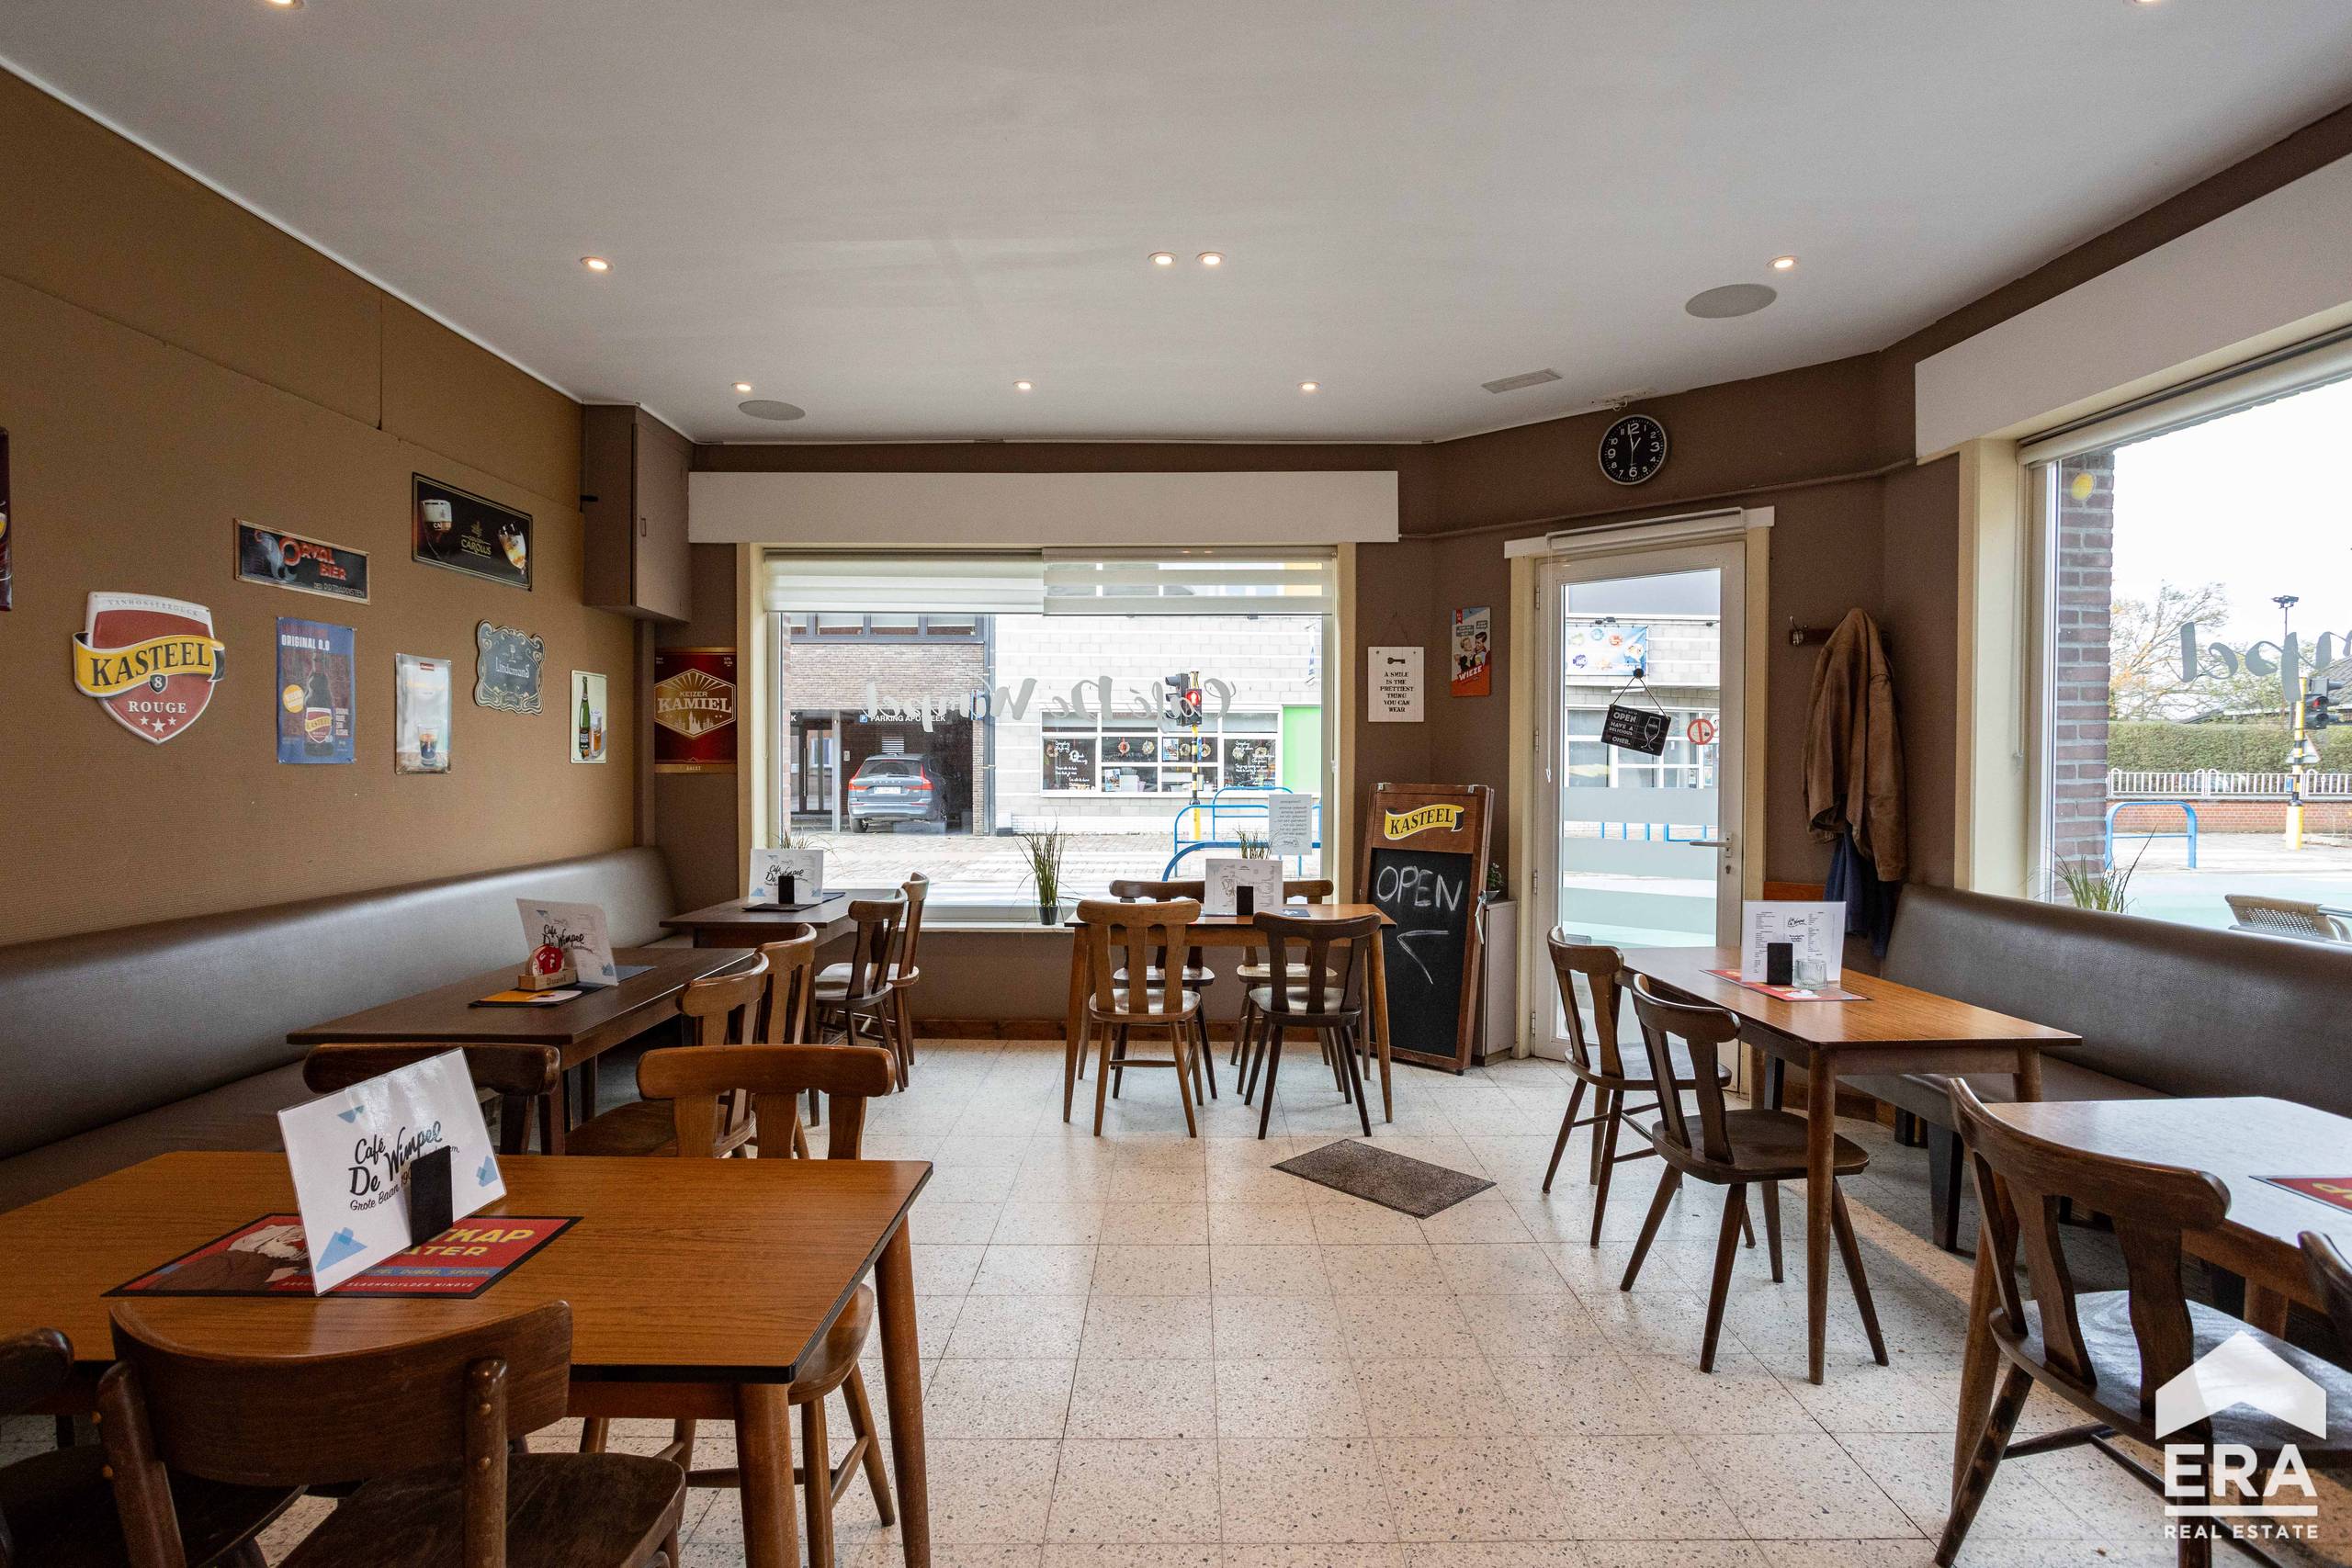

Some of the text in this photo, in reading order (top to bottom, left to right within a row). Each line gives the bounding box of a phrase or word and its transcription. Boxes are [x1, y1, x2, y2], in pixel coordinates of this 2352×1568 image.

[1607, 448, 1616, 459] 9
[1649, 441, 1660, 453] 3
[1629, 467, 1638, 478] 6
[278, 536, 336, 566] ORVAL
[319, 562, 347, 581] BIER
[281, 634, 316, 649] ORIGINAL
[90, 642, 210, 687] KASTEEL
[1458, 665, 1483, 682] WIEZE
[154, 676, 163, 688] 8
[128, 701, 187, 714] ROUGE
[657, 697, 732, 714] KAMIEL
[1613, 711, 1636, 722] OPEN
[1610, 721, 1626, 729] HAVE
[1390, 807, 1453, 835] KASTEEL
[1376, 865, 1463, 912] OPEN
[355, 1134, 386, 1166] Café
[348, 1121, 443, 1196] De Wimpel
[350, 1198, 376, 1211] Grote
